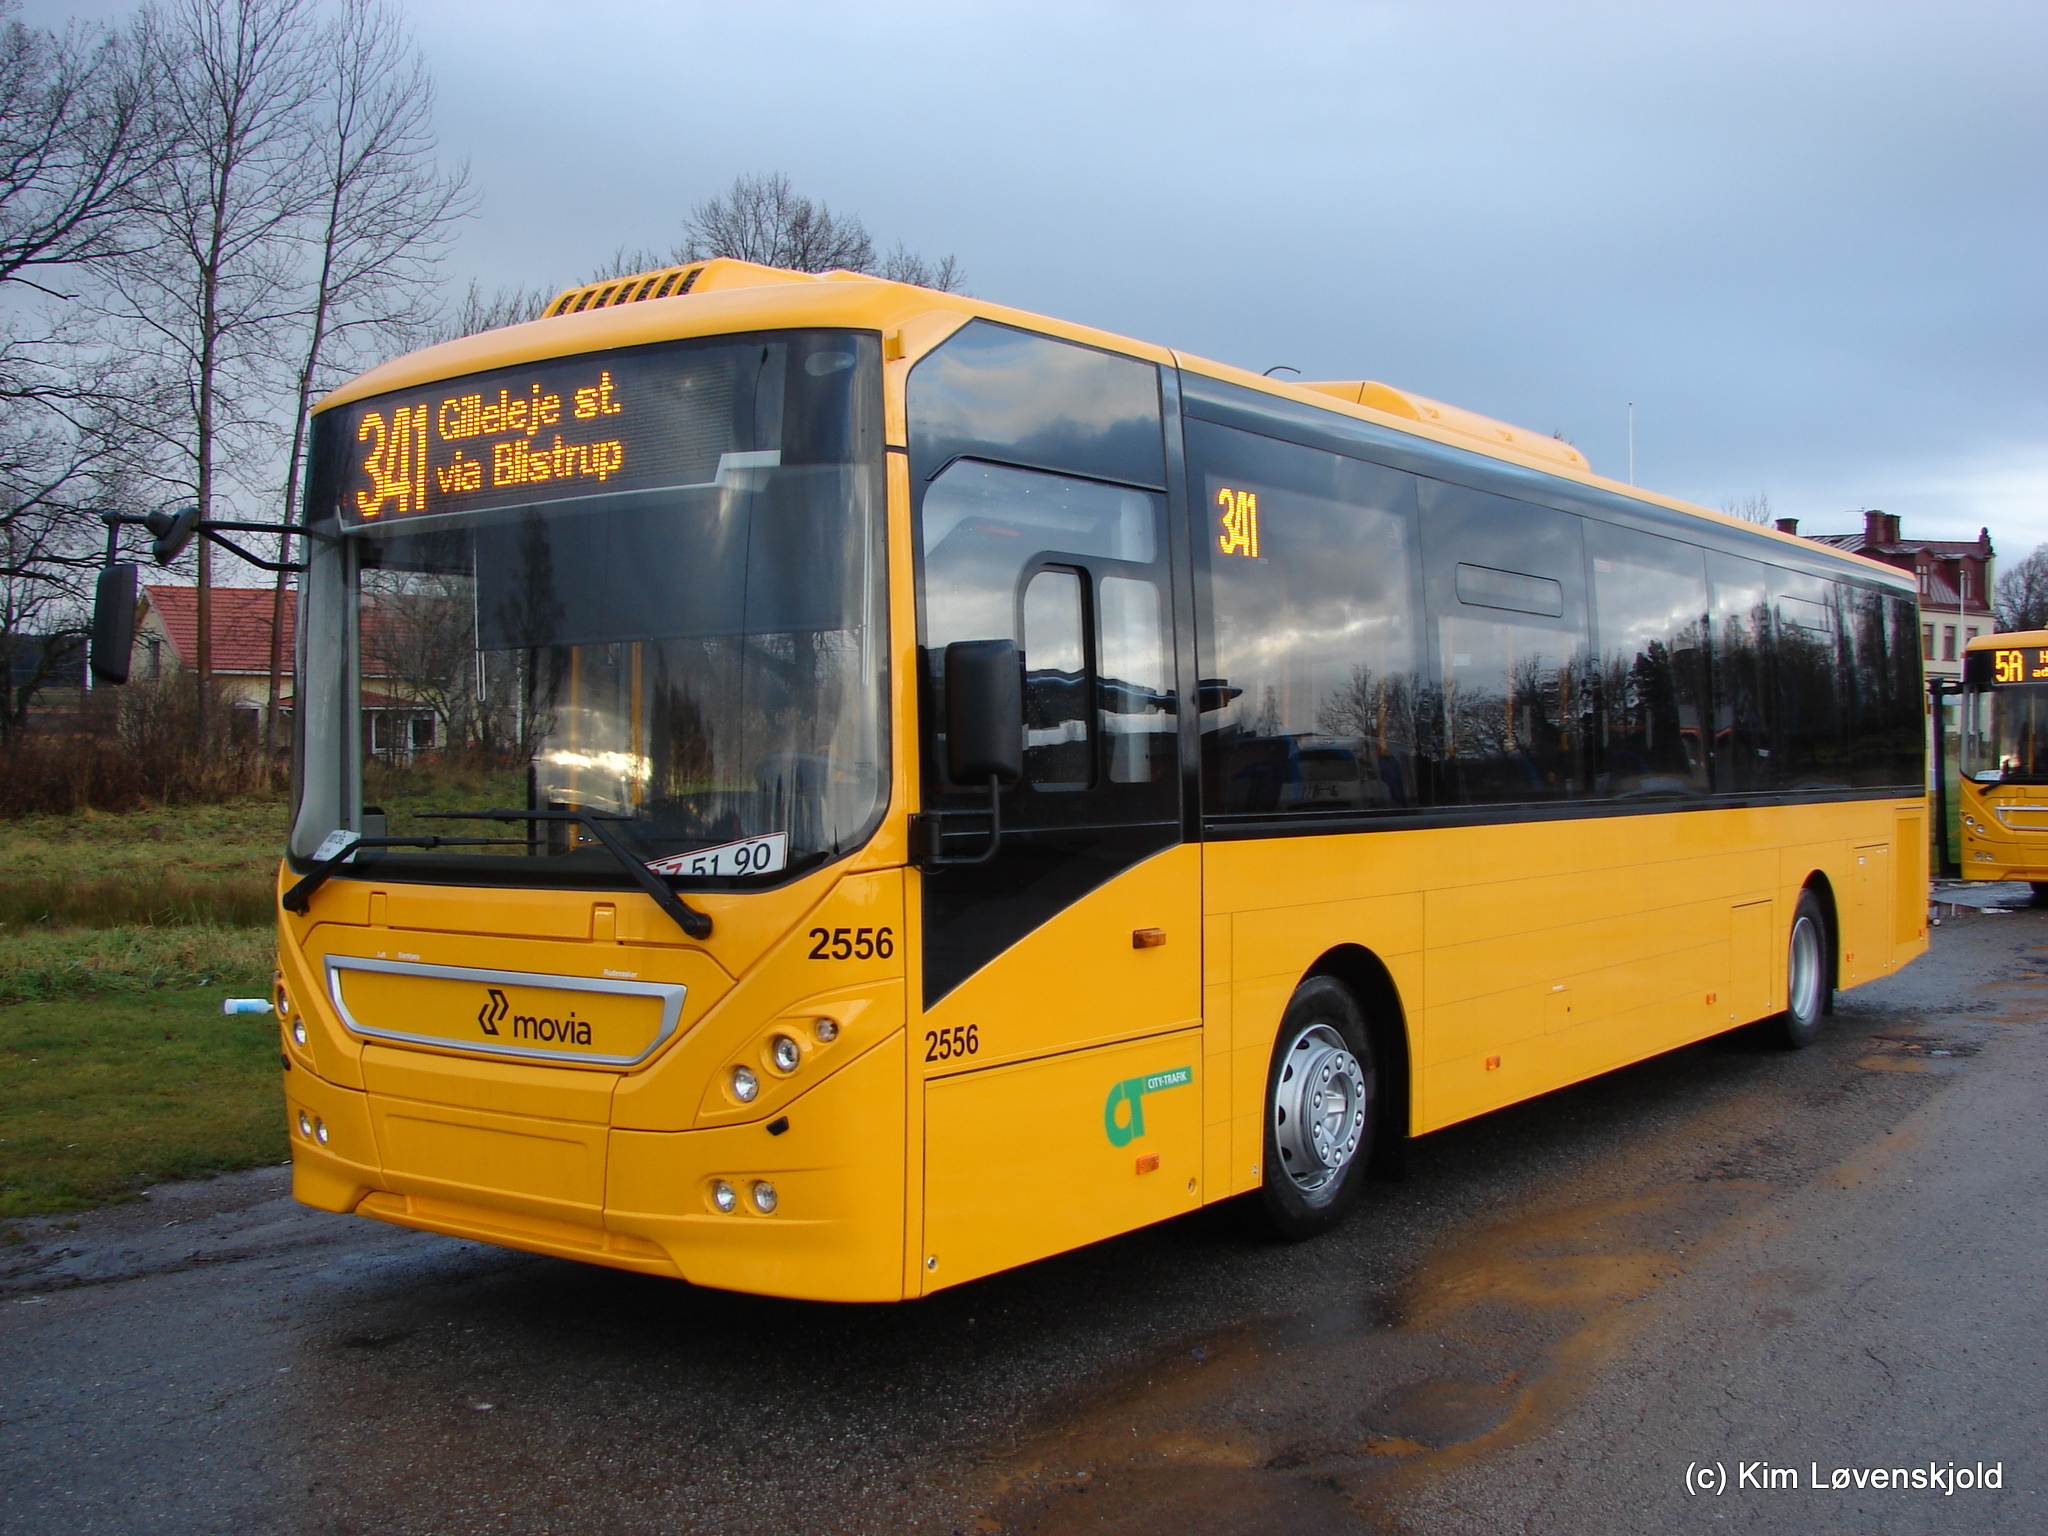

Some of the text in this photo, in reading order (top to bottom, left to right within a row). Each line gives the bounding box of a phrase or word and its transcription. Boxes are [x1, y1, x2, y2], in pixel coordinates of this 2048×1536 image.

[437, 371, 622, 440] Gilleleje st.
[356, 403, 428, 517] 341
[436, 435, 623, 493] via Blistrup
[1218, 487, 1258, 558] 341
[1994, 650, 2023, 682] 5A
[734, 843, 771, 875] 90
[808, 926, 893, 960] 2556
[513, 1011, 592, 1045] movia
[925, 1024, 979, 1063] 2556
[1147, 1071, 1188, 1089] CITY-TRAFIK
